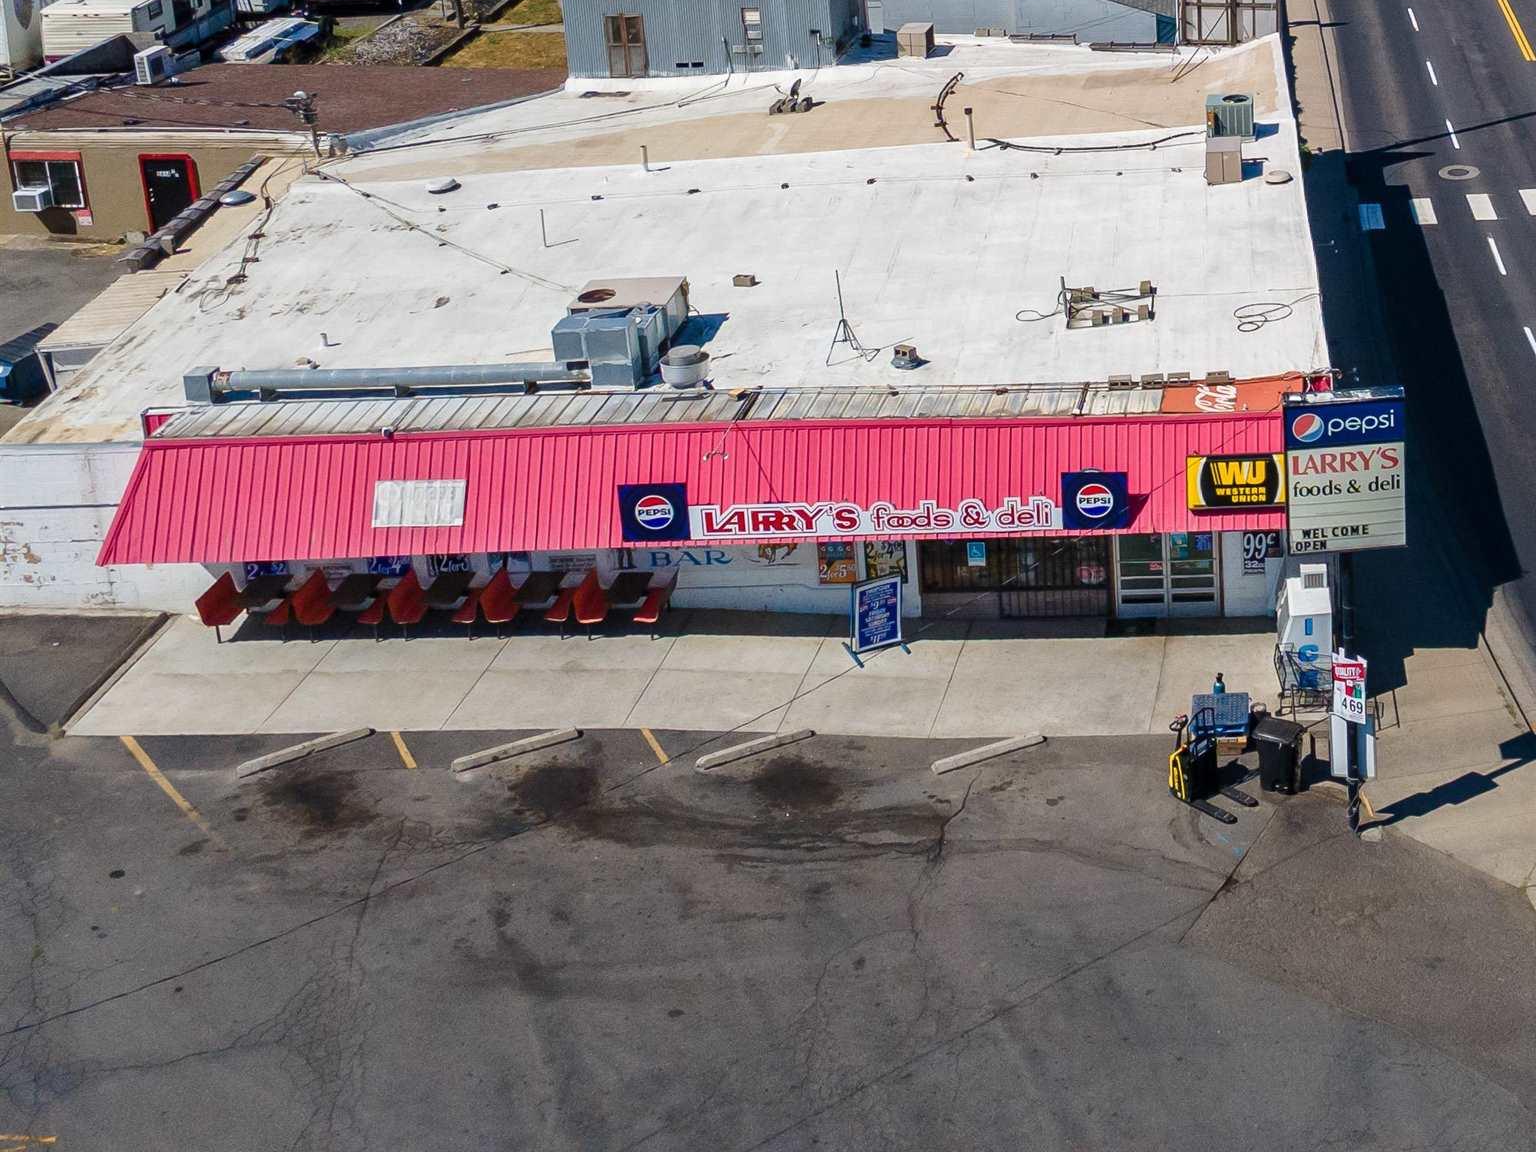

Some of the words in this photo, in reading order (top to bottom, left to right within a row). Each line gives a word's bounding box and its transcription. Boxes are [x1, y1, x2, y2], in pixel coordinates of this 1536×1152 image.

[1328, 409, 1395, 436] pepsi
[1292, 446, 1400, 476] LARRY'S
[1211, 460, 1266, 485] WU
[1215, 487, 1266, 496] WESTERN
[1293, 478, 1342, 498] foods
[1346, 479, 1361, 494] &
[1368, 474, 1401, 493] deli
[1078, 497, 1112, 505] PEPSI
[1231, 495, 1266, 503] UNION
[637, 508, 671, 517] PEPSI
[704, 505, 860, 533] LARRY'S
[873, 505, 951, 530] foods
[961, 504, 990, 528] &
[997, 503, 1051, 526] deli
[1295, 539, 1328, 552] OPEN
[650, 550, 733, 568] BAR
[1341, 697, 1364, 714] 469
